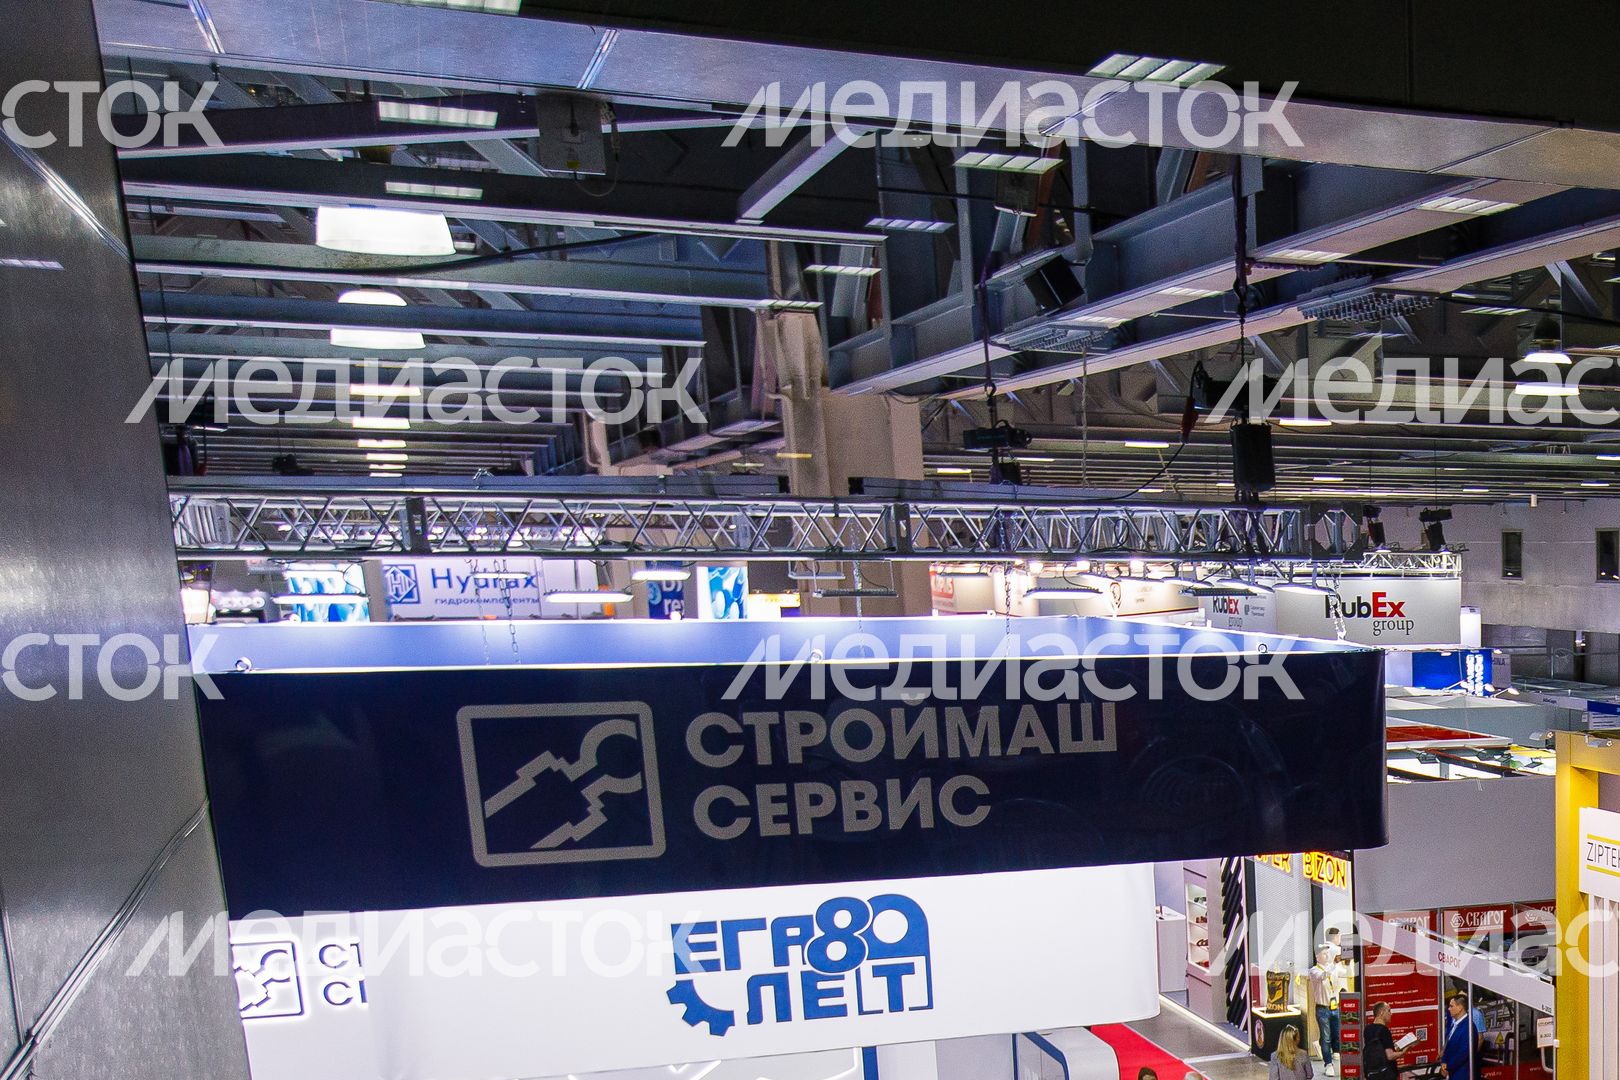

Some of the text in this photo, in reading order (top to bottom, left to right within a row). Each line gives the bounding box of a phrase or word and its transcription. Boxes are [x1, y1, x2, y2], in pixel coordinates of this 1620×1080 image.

[431, 567, 537, 595] Hydrax
[1325, 592, 1405, 619] RubEx
[1373, 618, 1415, 636] group
[685, 692, 1118, 768] СТРОЙМАШ
[693, 774, 992, 840] СЕРВИС
[1304, 851, 1348, 890] BIZON
[1465, 910, 1507, 930] СВАРОГ
